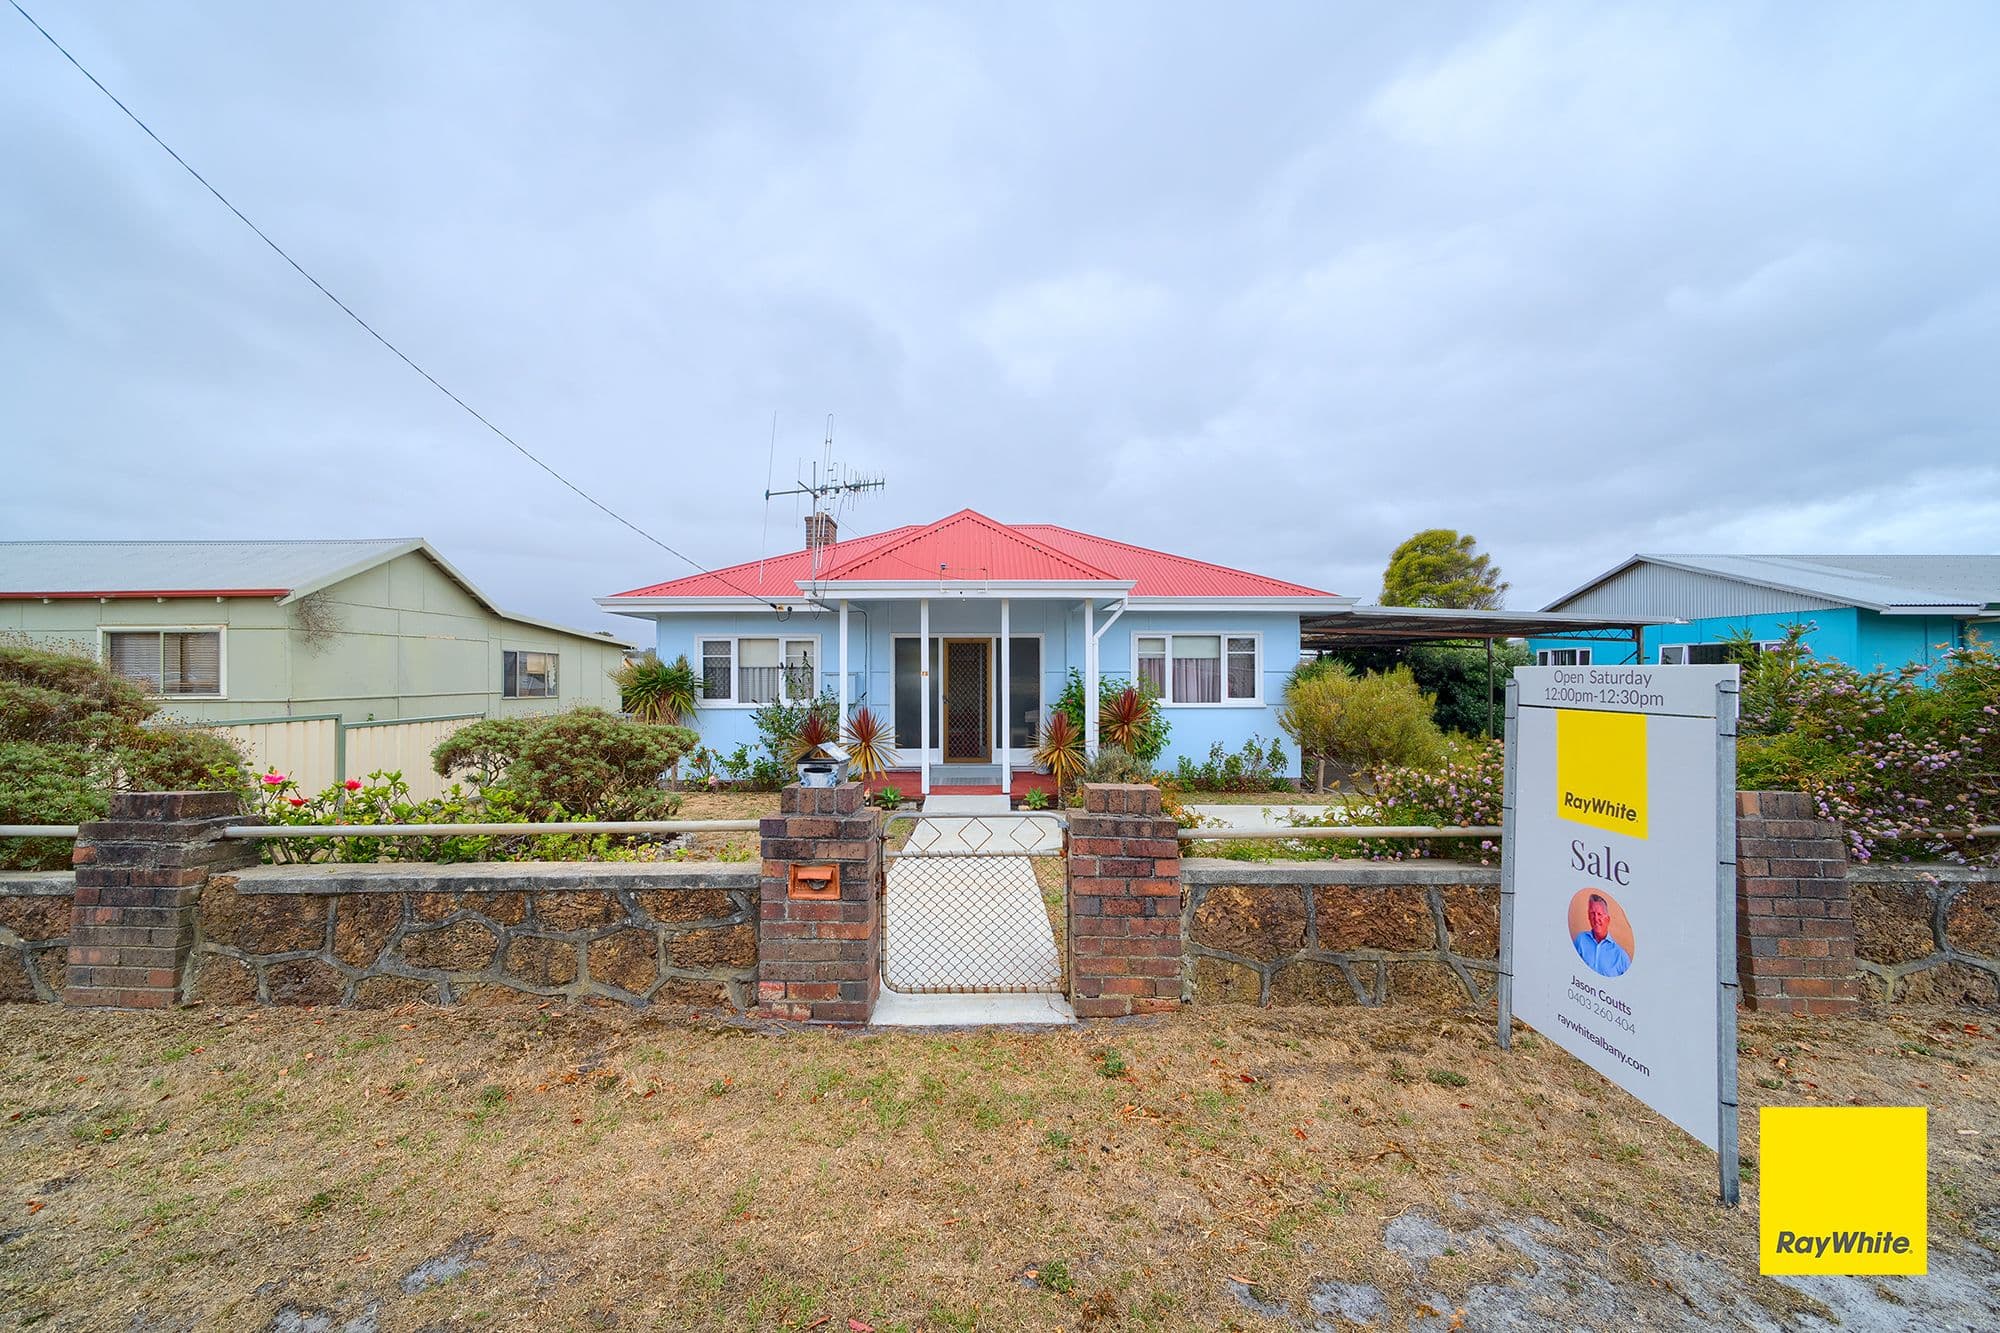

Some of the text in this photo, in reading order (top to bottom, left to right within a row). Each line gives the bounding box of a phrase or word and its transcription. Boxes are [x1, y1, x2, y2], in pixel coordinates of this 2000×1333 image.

[1544, 687, 1664, 707] 12:00pm-12:30pm
[1553, 670, 1653, 688] Open Saturday
[1571, 839, 1630, 886] Sale
[1567, 988, 1636, 1035] 0403 260 404
[1571, 975, 1633, 1016] Jason Coutts
[1557, 1013, 1650, 1077] raywhitealbany.com
